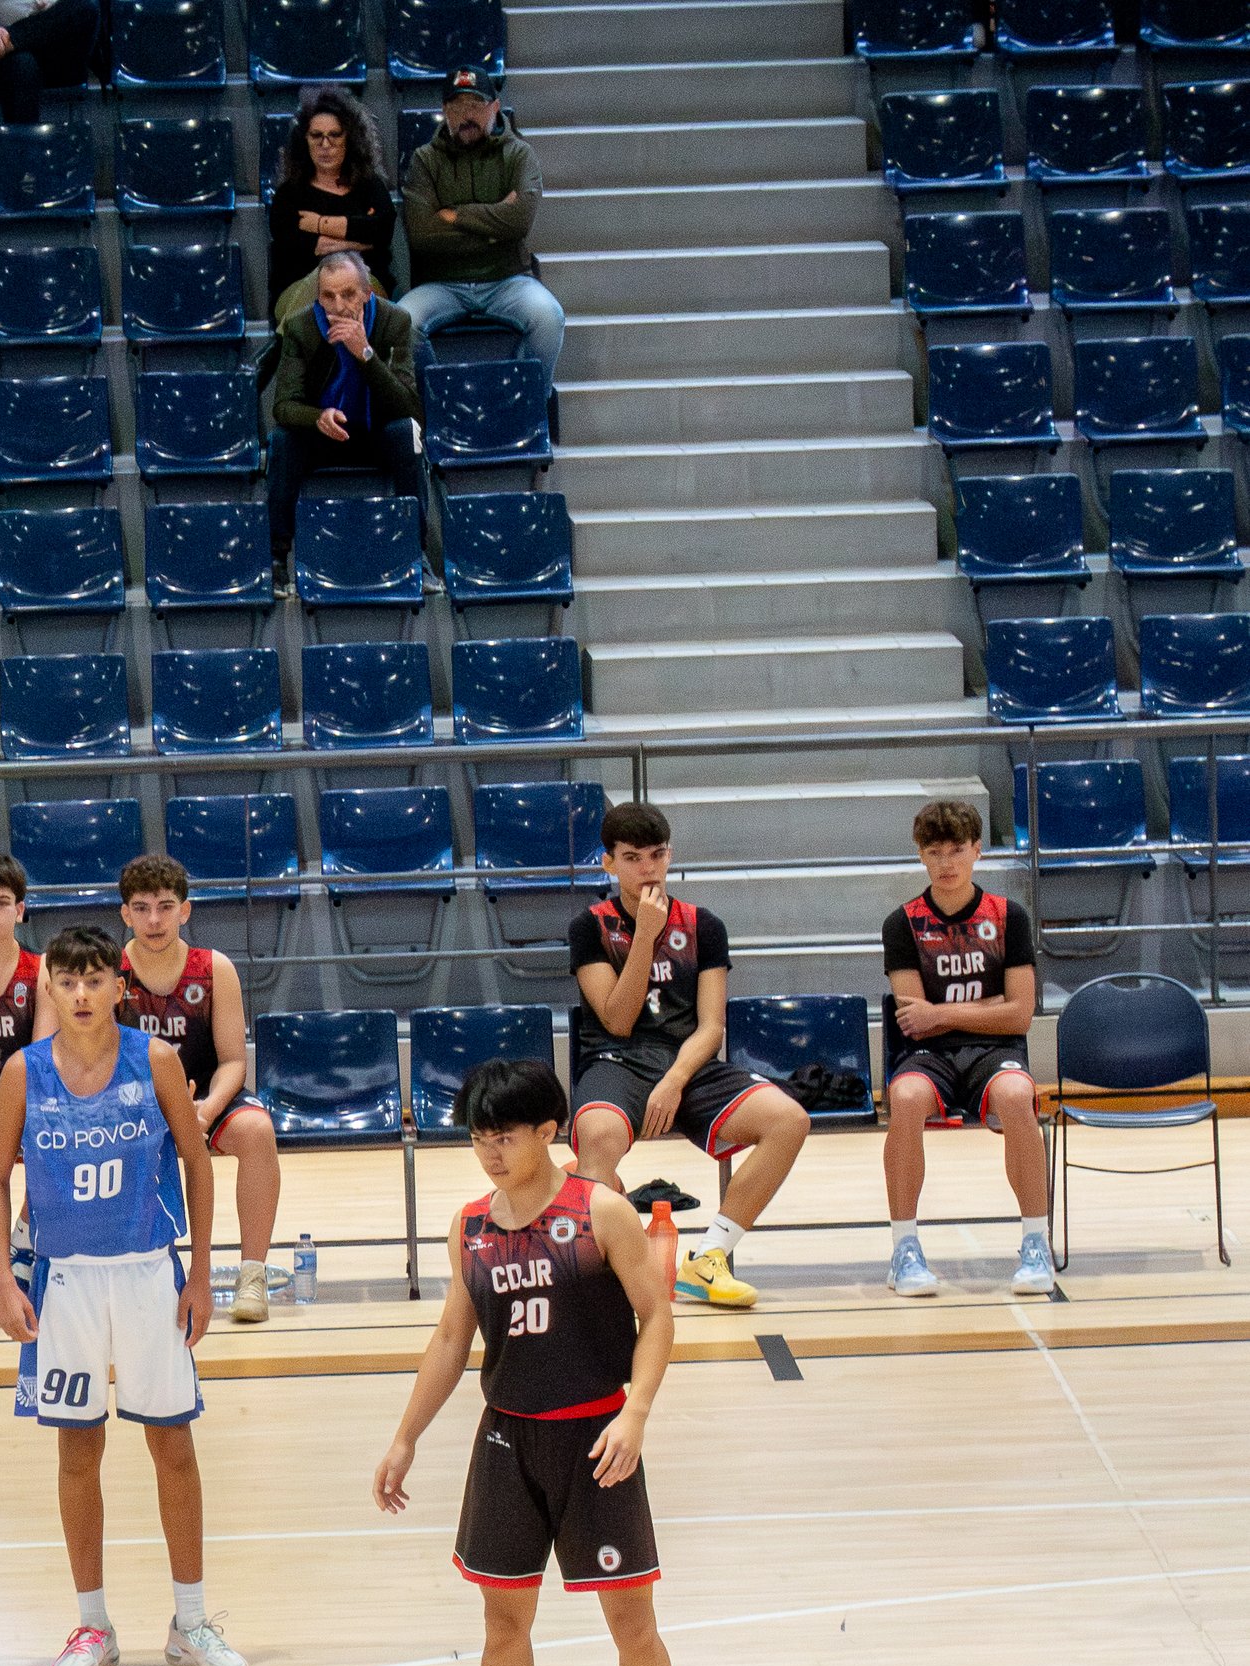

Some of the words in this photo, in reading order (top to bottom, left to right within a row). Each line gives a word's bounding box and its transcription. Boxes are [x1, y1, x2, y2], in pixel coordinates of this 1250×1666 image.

[650, 961, 673, 982] JR
[936, 951, 985, 976] CDJR
[139, 1014, 187, 1037] CDJR
[36, 1130, 67, 1150] CD
[73, 1158, 123, 1202] 90
[490, 1258, 553, 1294] CDJR
[508, 1297, 550, 1337] 20
[40, 1368, 91, 1408] 90
